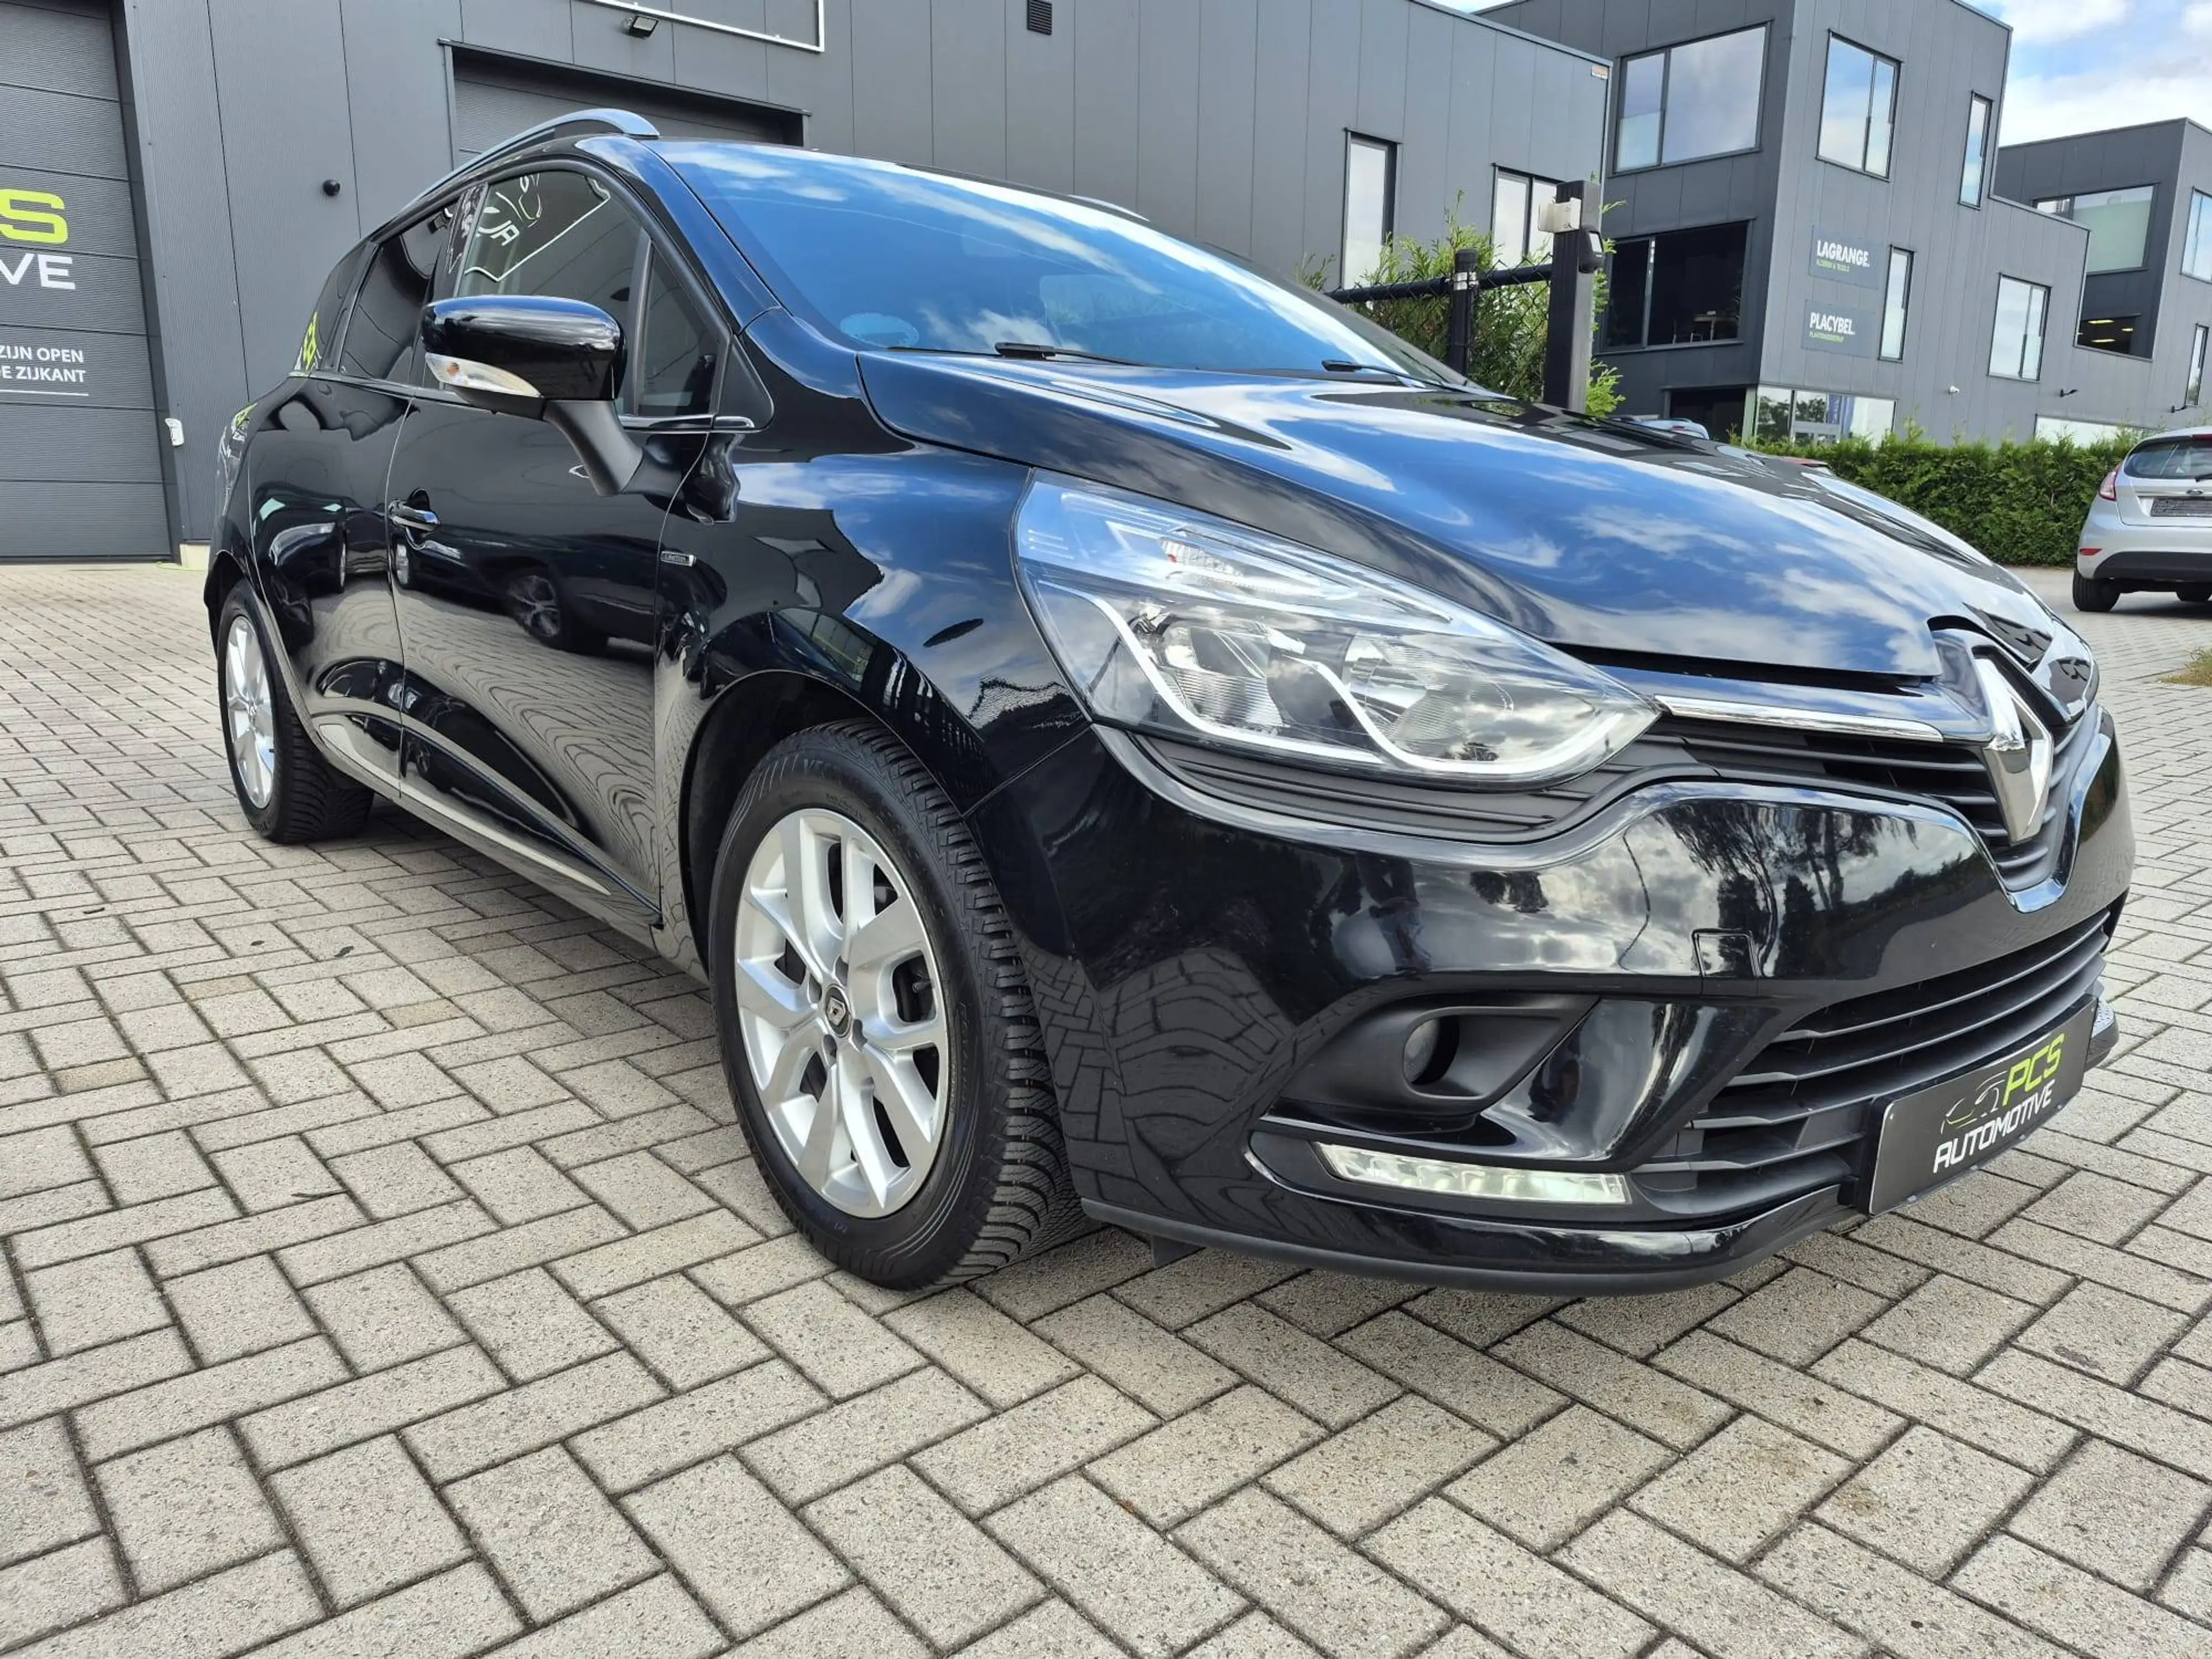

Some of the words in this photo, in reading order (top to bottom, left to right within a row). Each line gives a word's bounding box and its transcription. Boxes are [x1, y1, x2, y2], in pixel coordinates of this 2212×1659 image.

[16, 366, 86, 382] ZIJKANT
[36, 347, 84, 363] OPEN
[2002, 1033, 2065, 1106] PCS
[1933, 1078, 2056, 1173] AUTOMOTIVE
